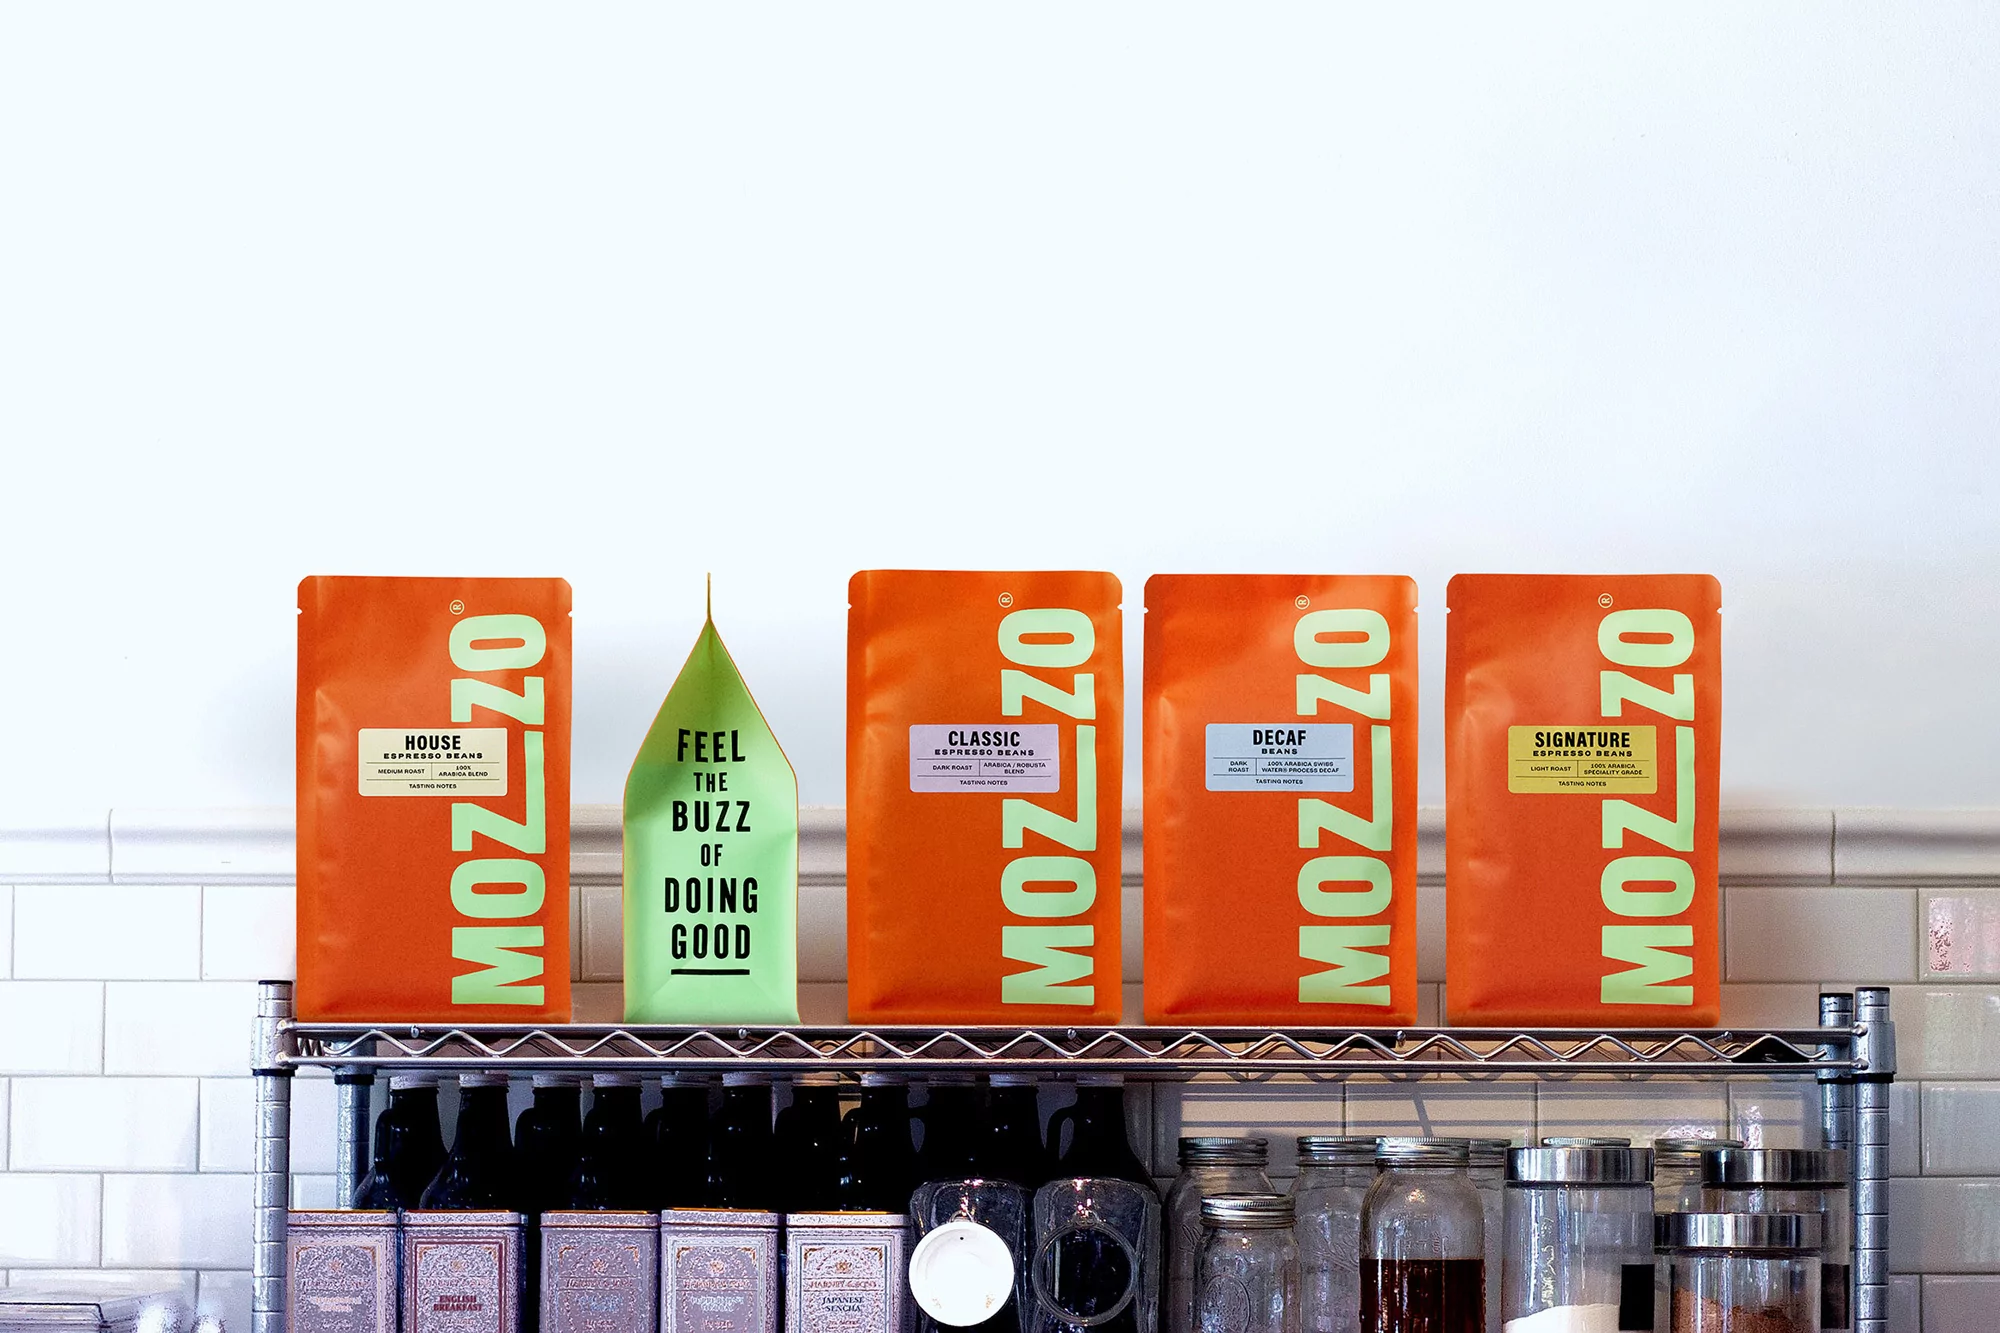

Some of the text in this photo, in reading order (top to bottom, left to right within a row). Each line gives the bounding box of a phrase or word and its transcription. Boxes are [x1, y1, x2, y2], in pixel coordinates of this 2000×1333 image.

[405, 735, 461, 750] HOUSE
[949, 731, 1020, 746] CLASSIC
[1253, 730, 1306, 745] DECAF
[1535, 732, 1629, 747] SIGNATURE
[677, 728, 745, 763] FEEL
[694, 772, 728, 793] THE
[672, 801, 751, 833] BUZZ
[700, 843, 722, 867] OF
[665, 878, 758, 913] DOING
[671, 924, 750, 960] GOOD
[439, 1295, 476, 1303] ENGLISH
[821, 1297, 863, 1305] JAPANESE
[433, 1303, 482, 1311] BREAKFAST
